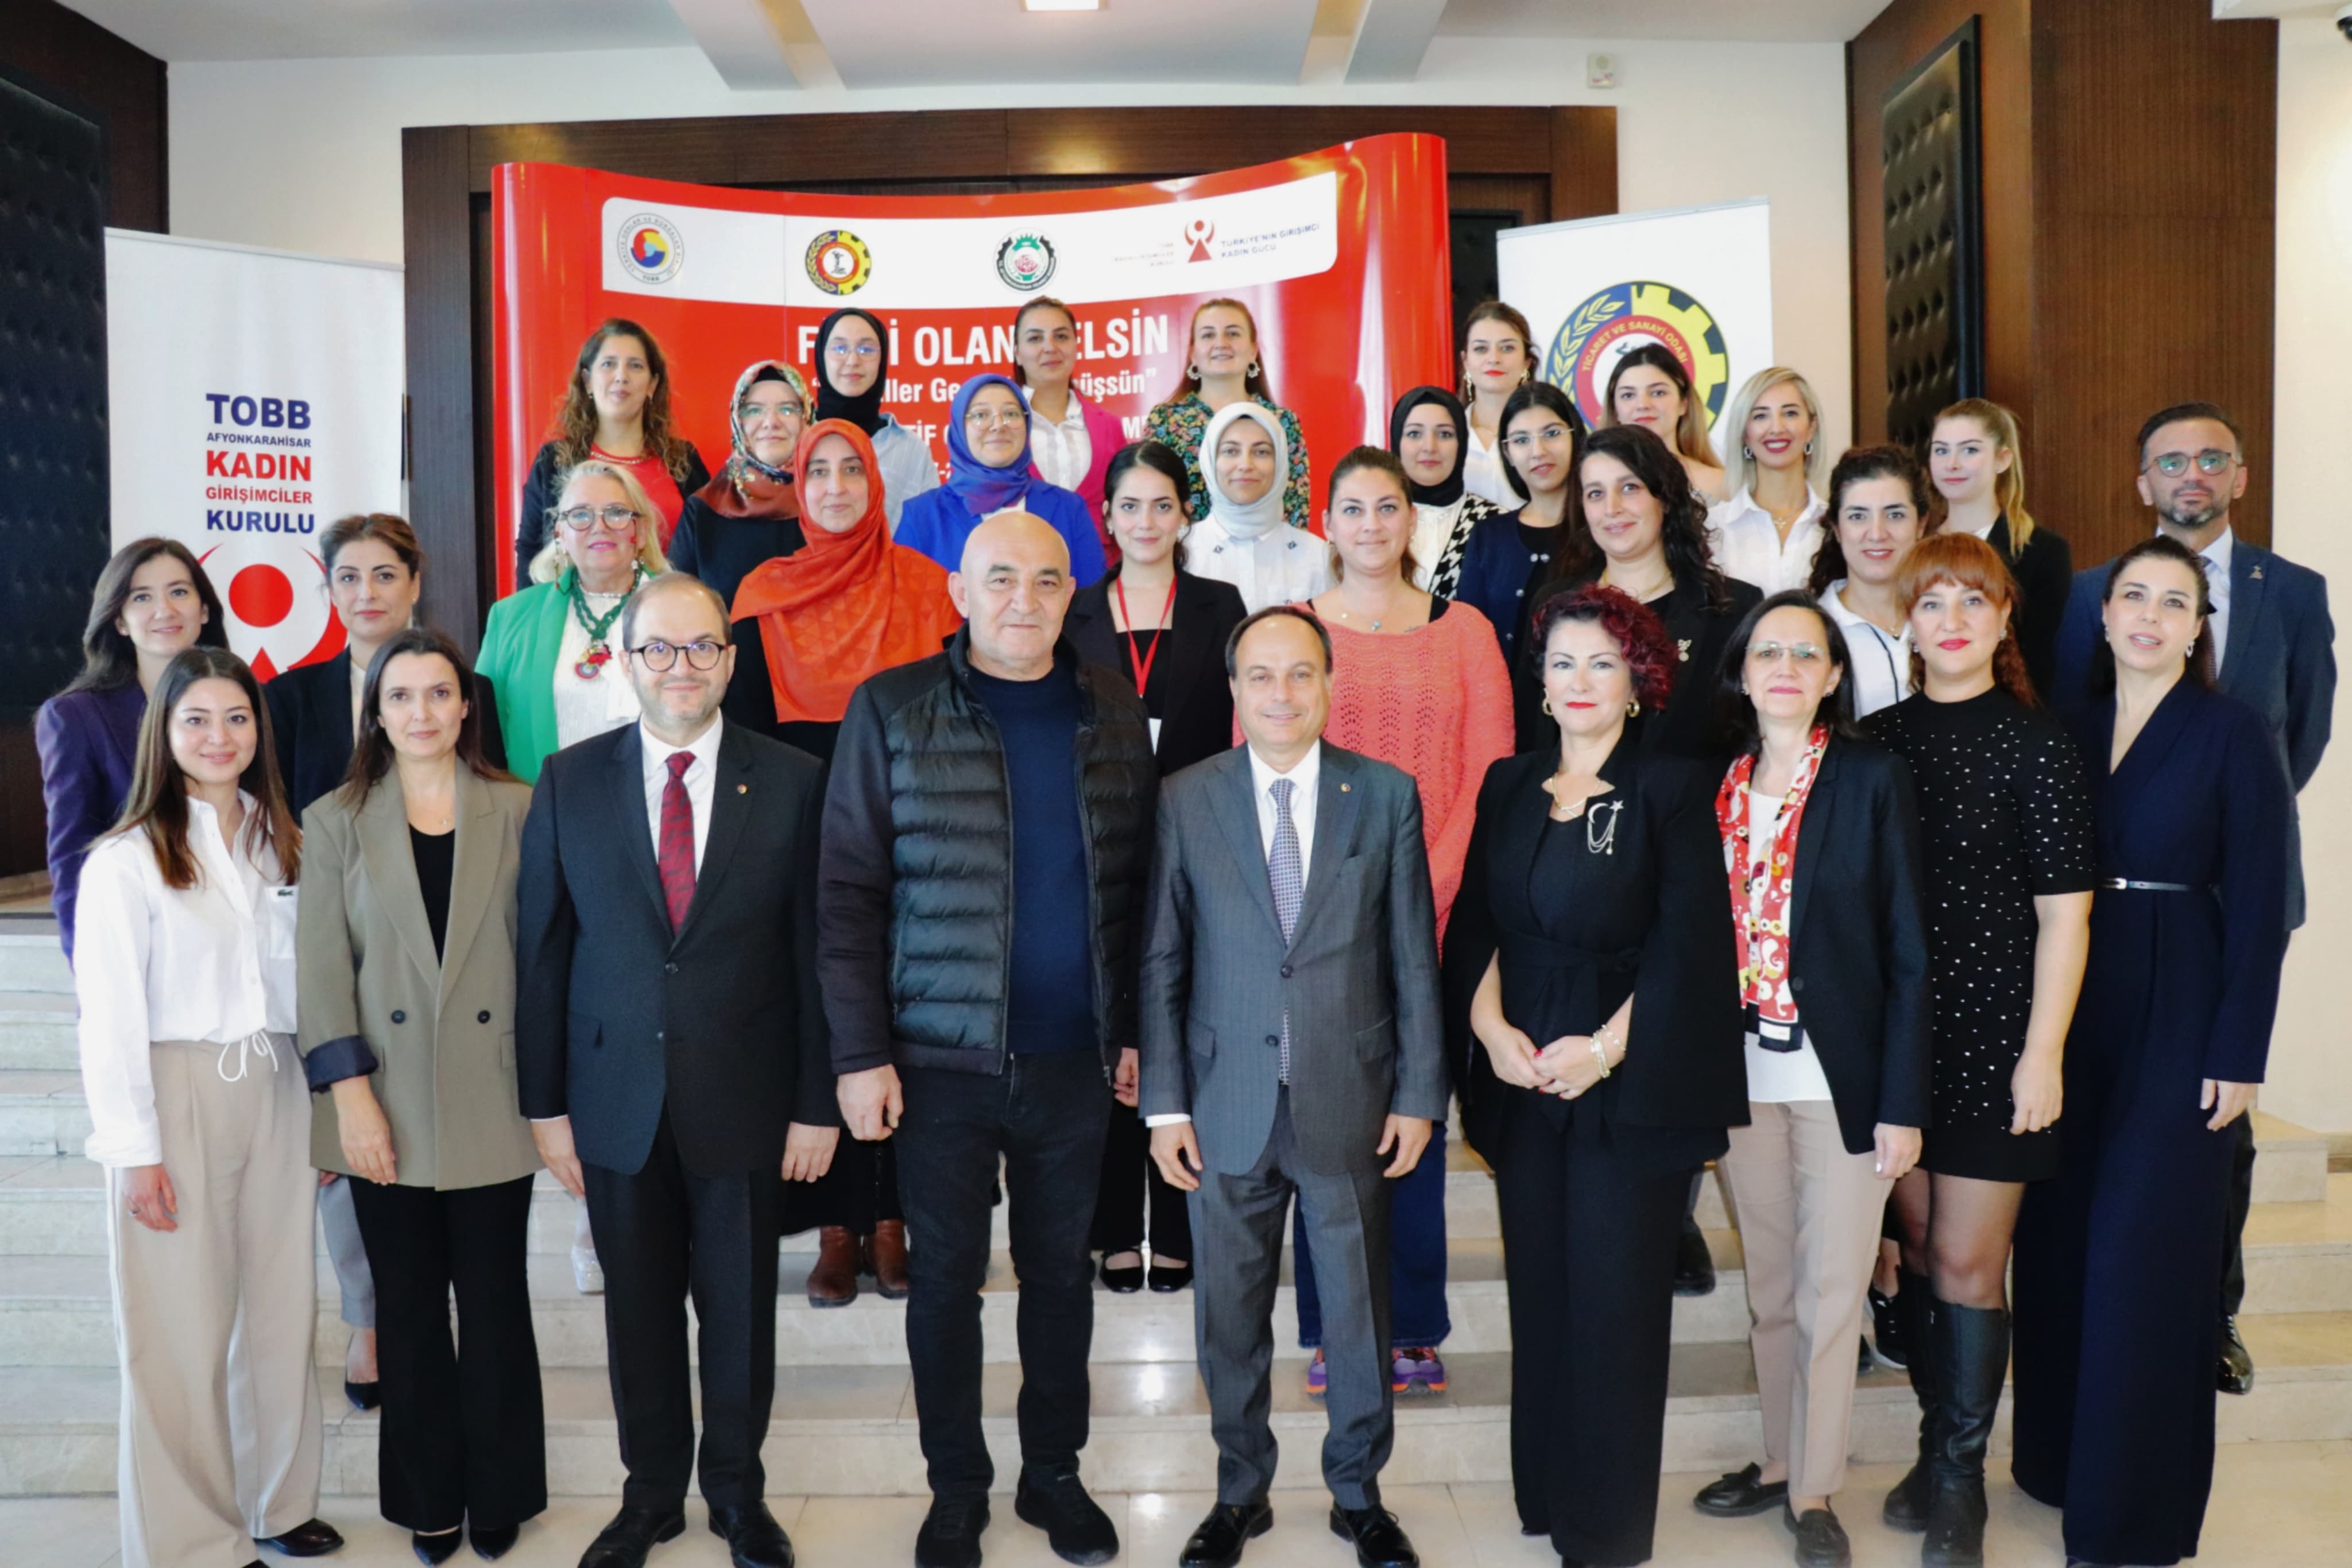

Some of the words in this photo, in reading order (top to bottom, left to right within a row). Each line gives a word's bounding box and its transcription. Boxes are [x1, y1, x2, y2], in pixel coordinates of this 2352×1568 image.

[1222, 249, 1249, 258] KADIN
[914, 326, 1015, 366] OLAN
[1076, 308, 1169, 360] LSİN
[1583, 331, 1611, 372] TİCARET
[1611, 323, 1627, 335] VE
[1628, 321, 1667, 335] SANAYİ
[1666, 333, 1688, 363] ODASI
[206, 393, 311, 429] TOBB
[207, 432, 311, 448] AFYONKARAHİSAR
[206, 450, 311, 481] KADIN
[206, 485, 312, 504] GİRİŞİMCİLER
[207, 509, 314, 534] KURULU
